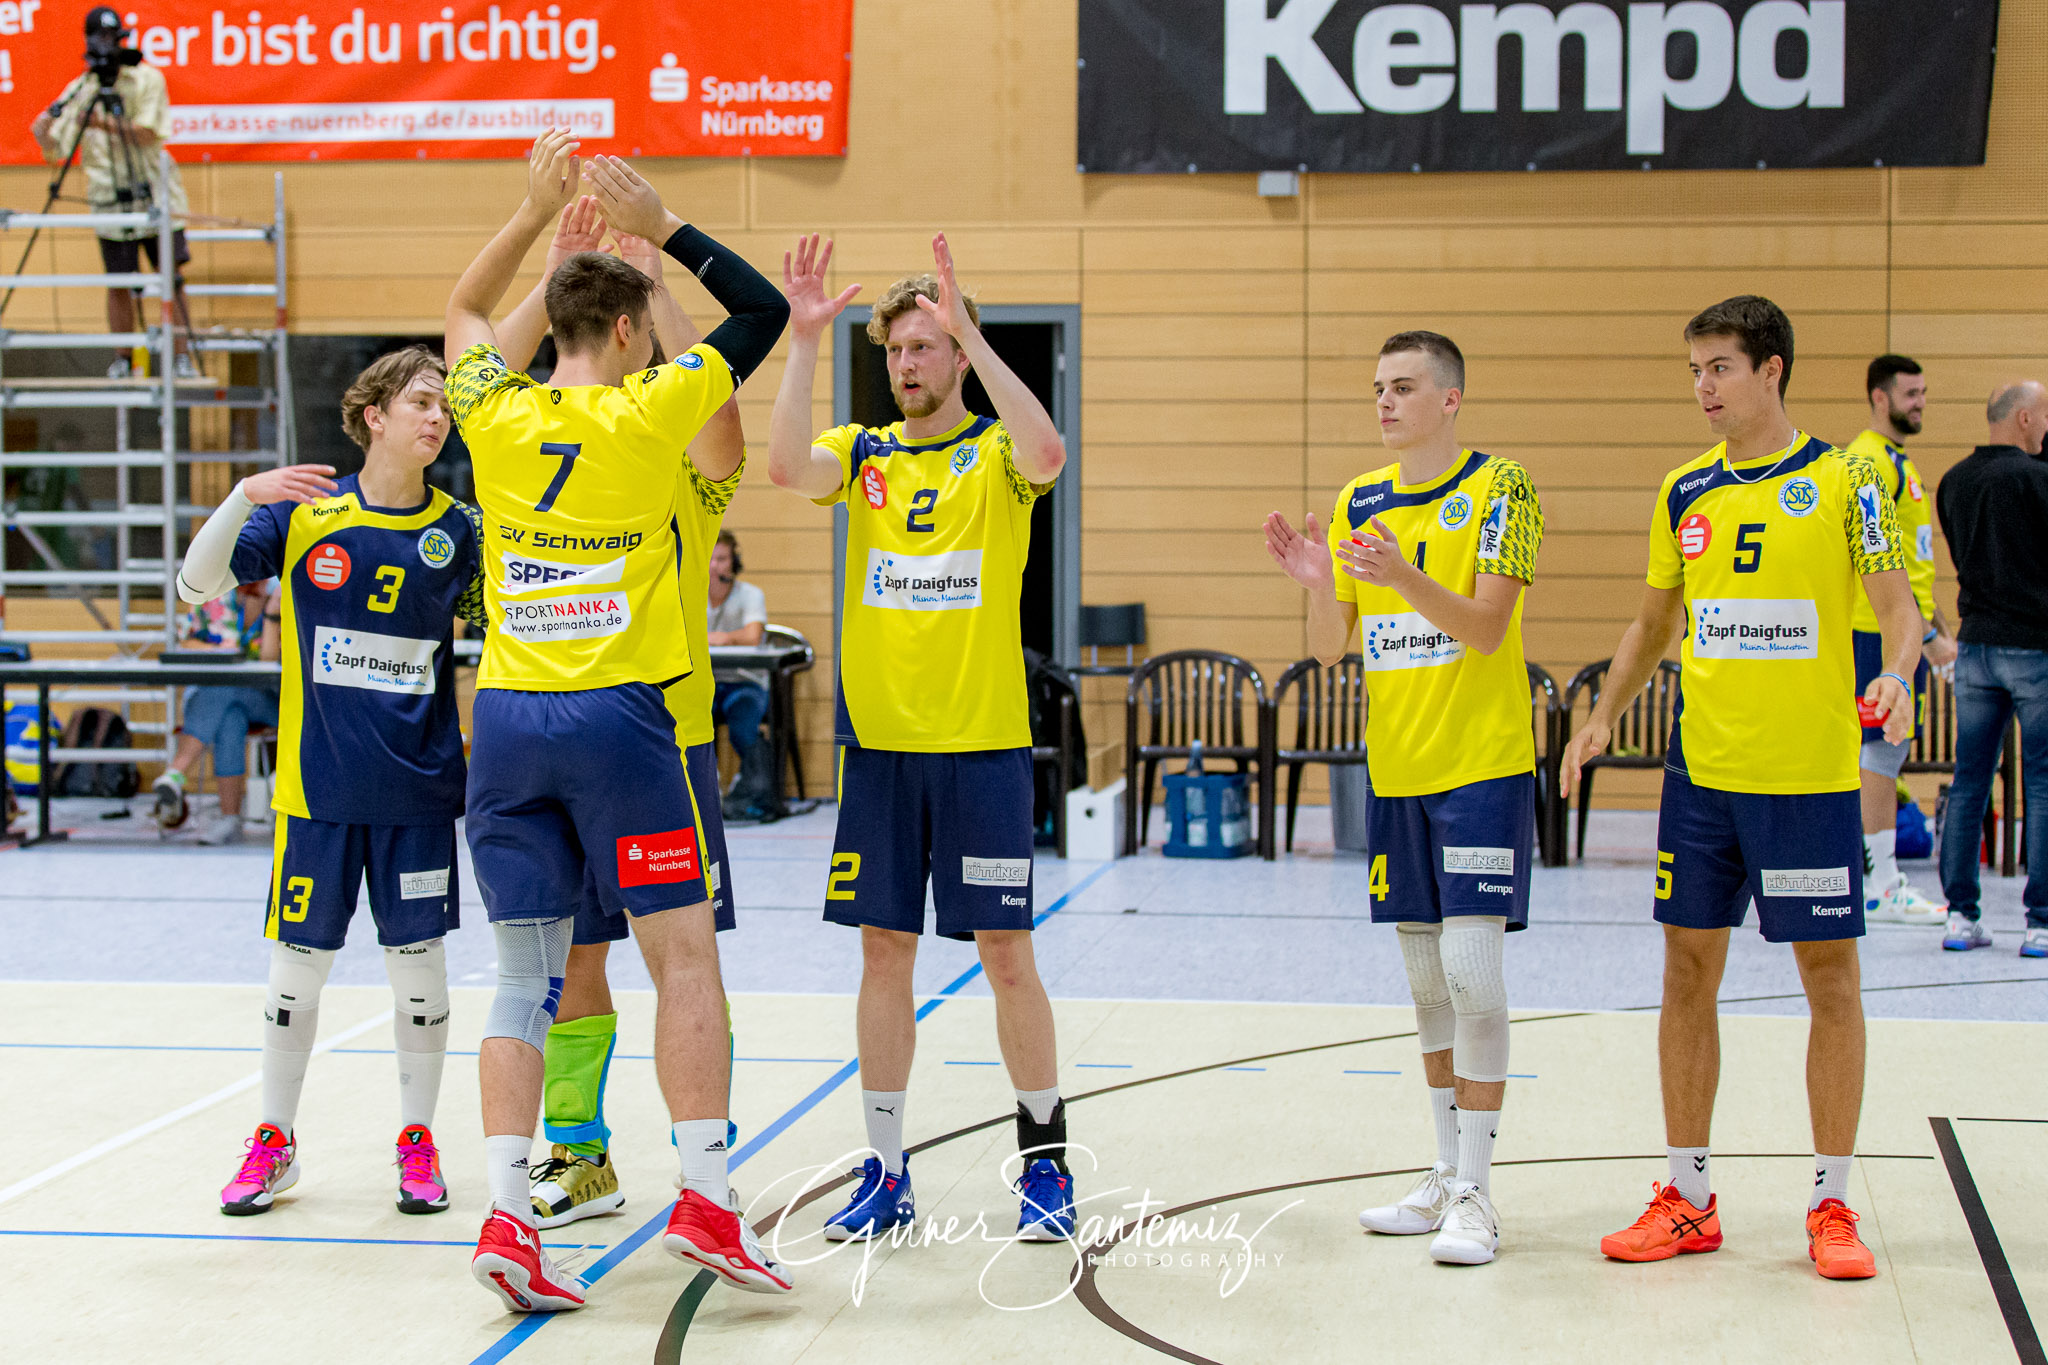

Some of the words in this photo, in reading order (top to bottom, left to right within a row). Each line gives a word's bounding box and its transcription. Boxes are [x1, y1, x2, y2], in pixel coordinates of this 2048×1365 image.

[123, 11, 199, 67] ier
[211, 10, 318, 66] bist
[329, 8, 400, 65] du
[419, 4, 617, 74] richtig.
[700, 75, 834, 106] Sparkasse
[1223, 0, 1846, 155] Kempa
[171, 104, 604, 139] parkasse-nuernberg.de/ausbildung
[701, 110, 824, 141] Nürnberg
[534, 442, 582, 513] 7
[312, 505, 350, 517] Kempa
[906, 488, 938, 533] 2
[499, 525, 526, 543] SV
[532, 530, 643, 552] Schwaig
[1733, 522, 1767, 574] 5
[367, 564, 406, 614] 3
[885, 575, 909, 592] Zapf
[912, 576, 978, 593] Daigfuss
[505, 598, 619, 620] SPORTNANKA
[511, 613, 622, 634] www.sportnanka.de
[1706, 623, 1737, 641] Zapf
[1739, 624, 1808, 641] Daigfuss
[1382, 635, 1408, 652] Zapf
[1409, 632, 1459, 649] Daigfus
[335, 652, 367, 669] Zapf
[368, 657, 428, 676] Daigfuss
[647, 846, 691, 861] Sparkasse
[648, 860, 691, 872] Nürnberg
[403, 874, 448, 892] HÜTTIN
[826, 852, 862, 901] 2
[1368, 854, 1390, 902] 4
[1654, 849, 1675, 900] 5
[1766, 873, 1847, 889] HÜTTINGER
[282, 875, 314, 923] 3
[1478, 882, 1514, 896] Kempa
[1811, 905, 1852, 918] Kempa
